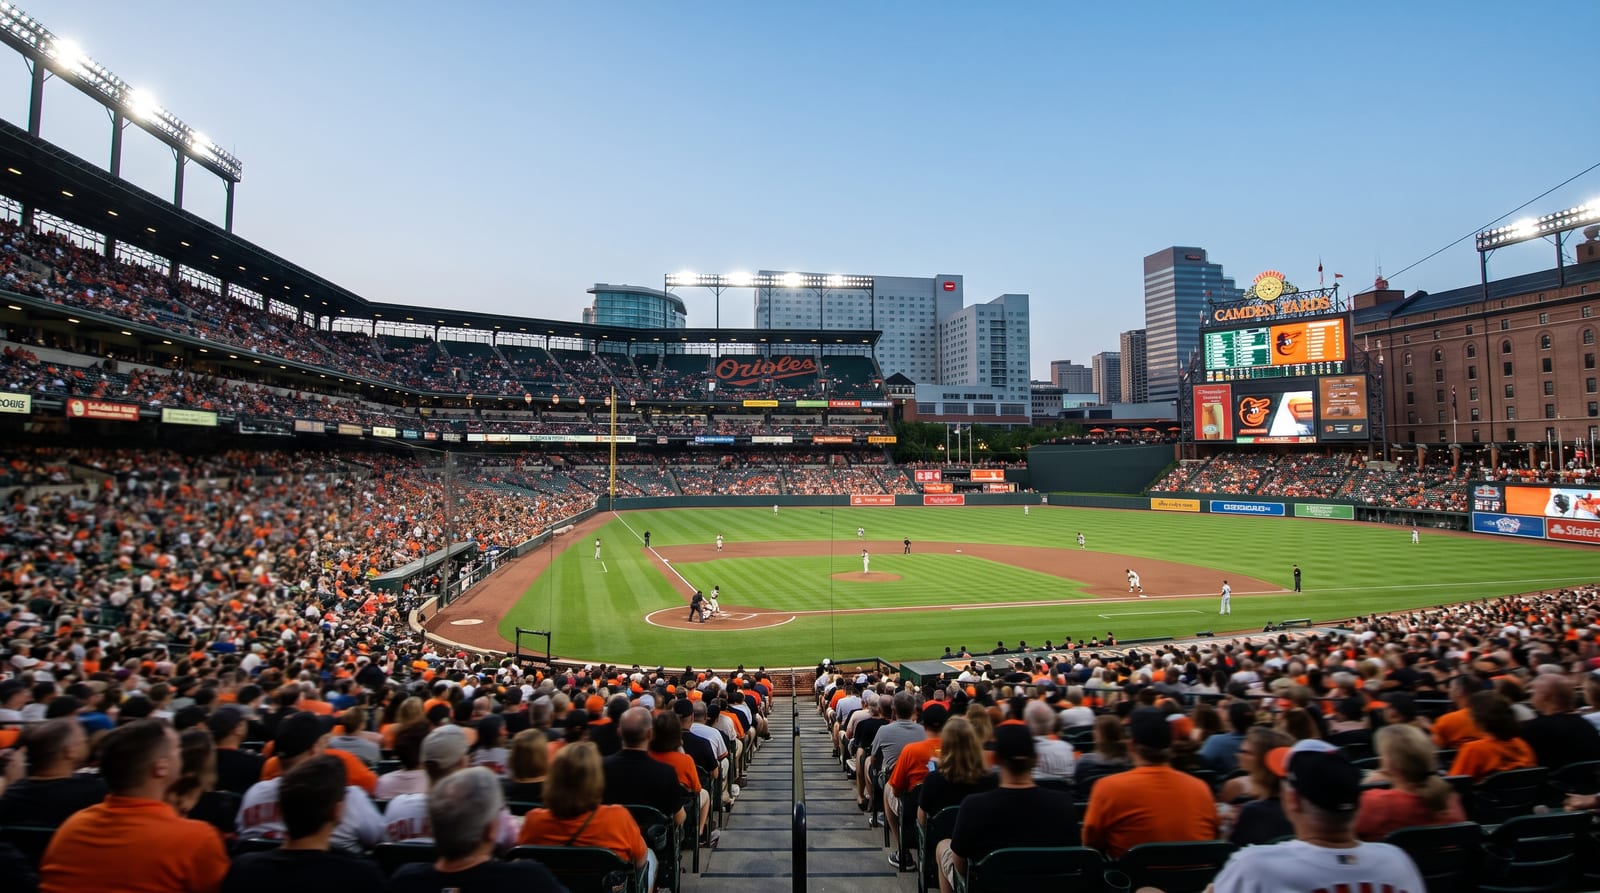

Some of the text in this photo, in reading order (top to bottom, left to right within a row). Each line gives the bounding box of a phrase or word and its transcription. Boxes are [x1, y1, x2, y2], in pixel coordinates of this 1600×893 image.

[1214, 295, 1331, 321] CAMDEN YARDS
[716, 356, 818, 380] Orioles
